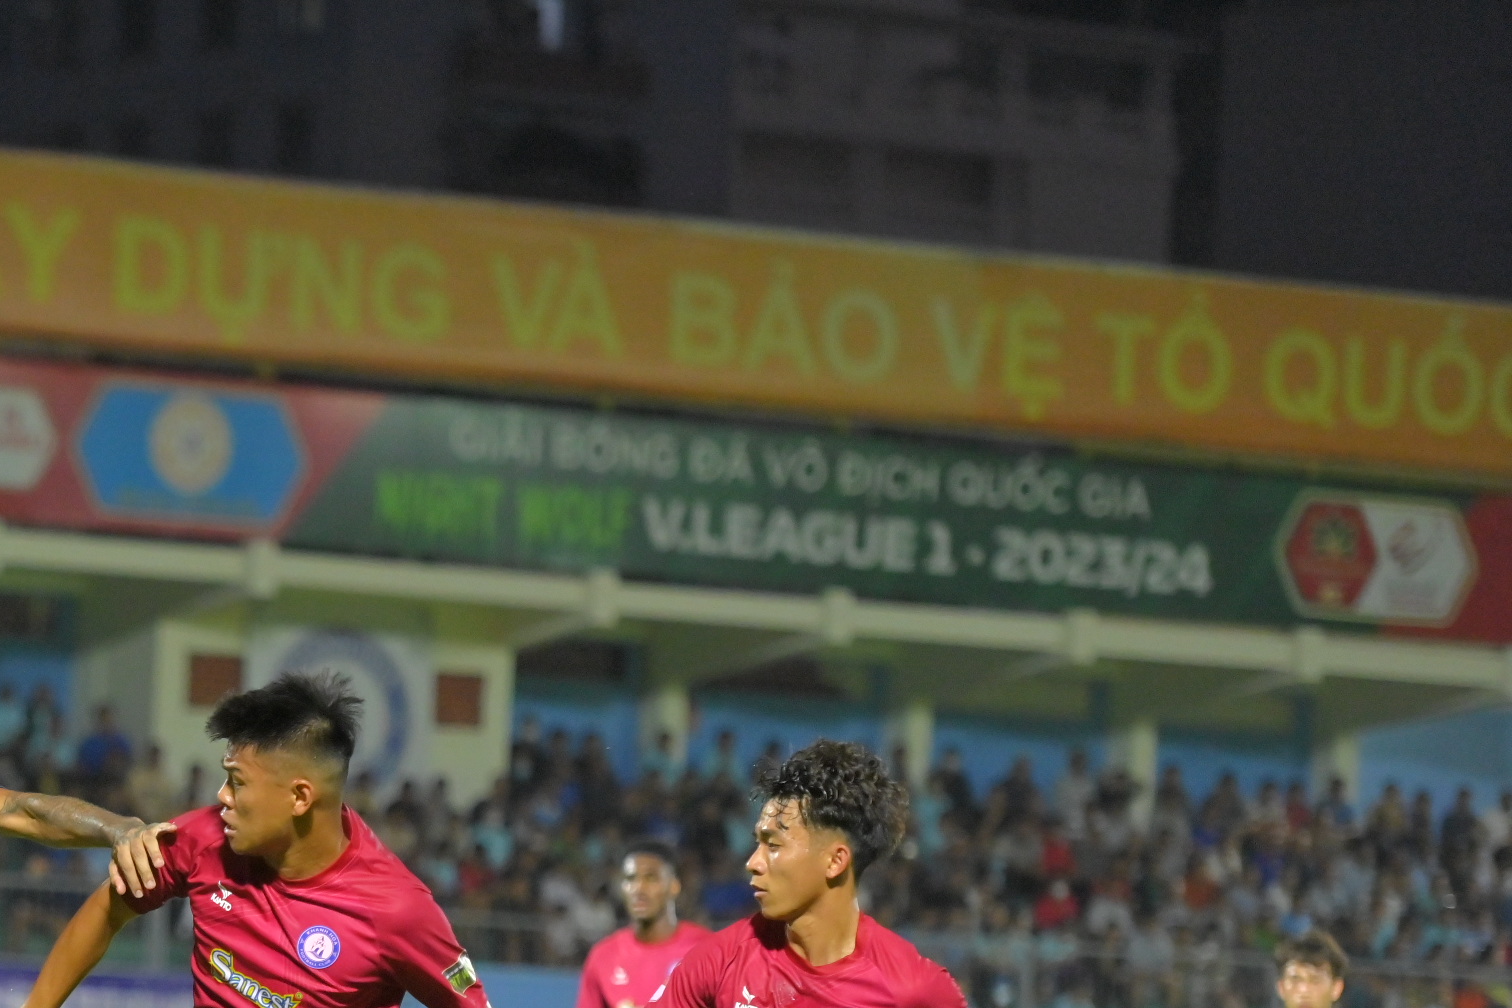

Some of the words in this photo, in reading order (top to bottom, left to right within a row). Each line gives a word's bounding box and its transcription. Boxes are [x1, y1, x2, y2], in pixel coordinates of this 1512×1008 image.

[111, 214, 455, 345] DỰNG
[492, 237, 624, 357] VÀ
[668, 260, 897, 385] BẢO
[642, 496, 918, 575] V.LEAGUE
[925, 520, 956, 576] 1
[992, 523, 1214, 598] 2023/24
